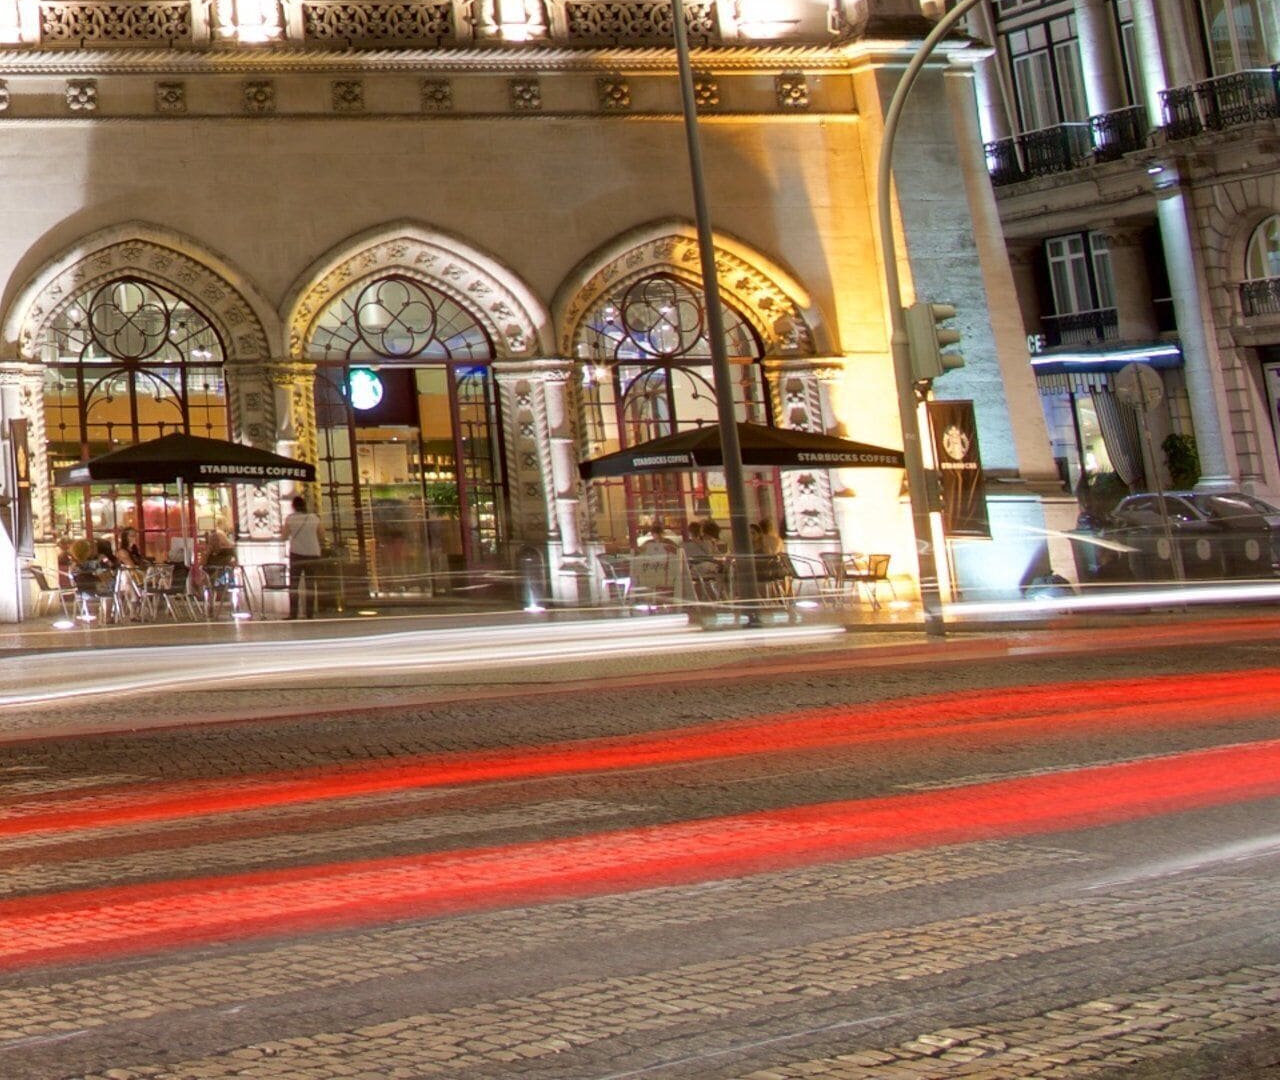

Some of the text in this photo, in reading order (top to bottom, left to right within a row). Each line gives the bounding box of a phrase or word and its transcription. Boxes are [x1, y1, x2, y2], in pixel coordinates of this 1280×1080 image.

[797, 452, 898, 464] STARBUCKS COFFEE
[200, 465, 307, 477] STARBUCKS COFFEE
